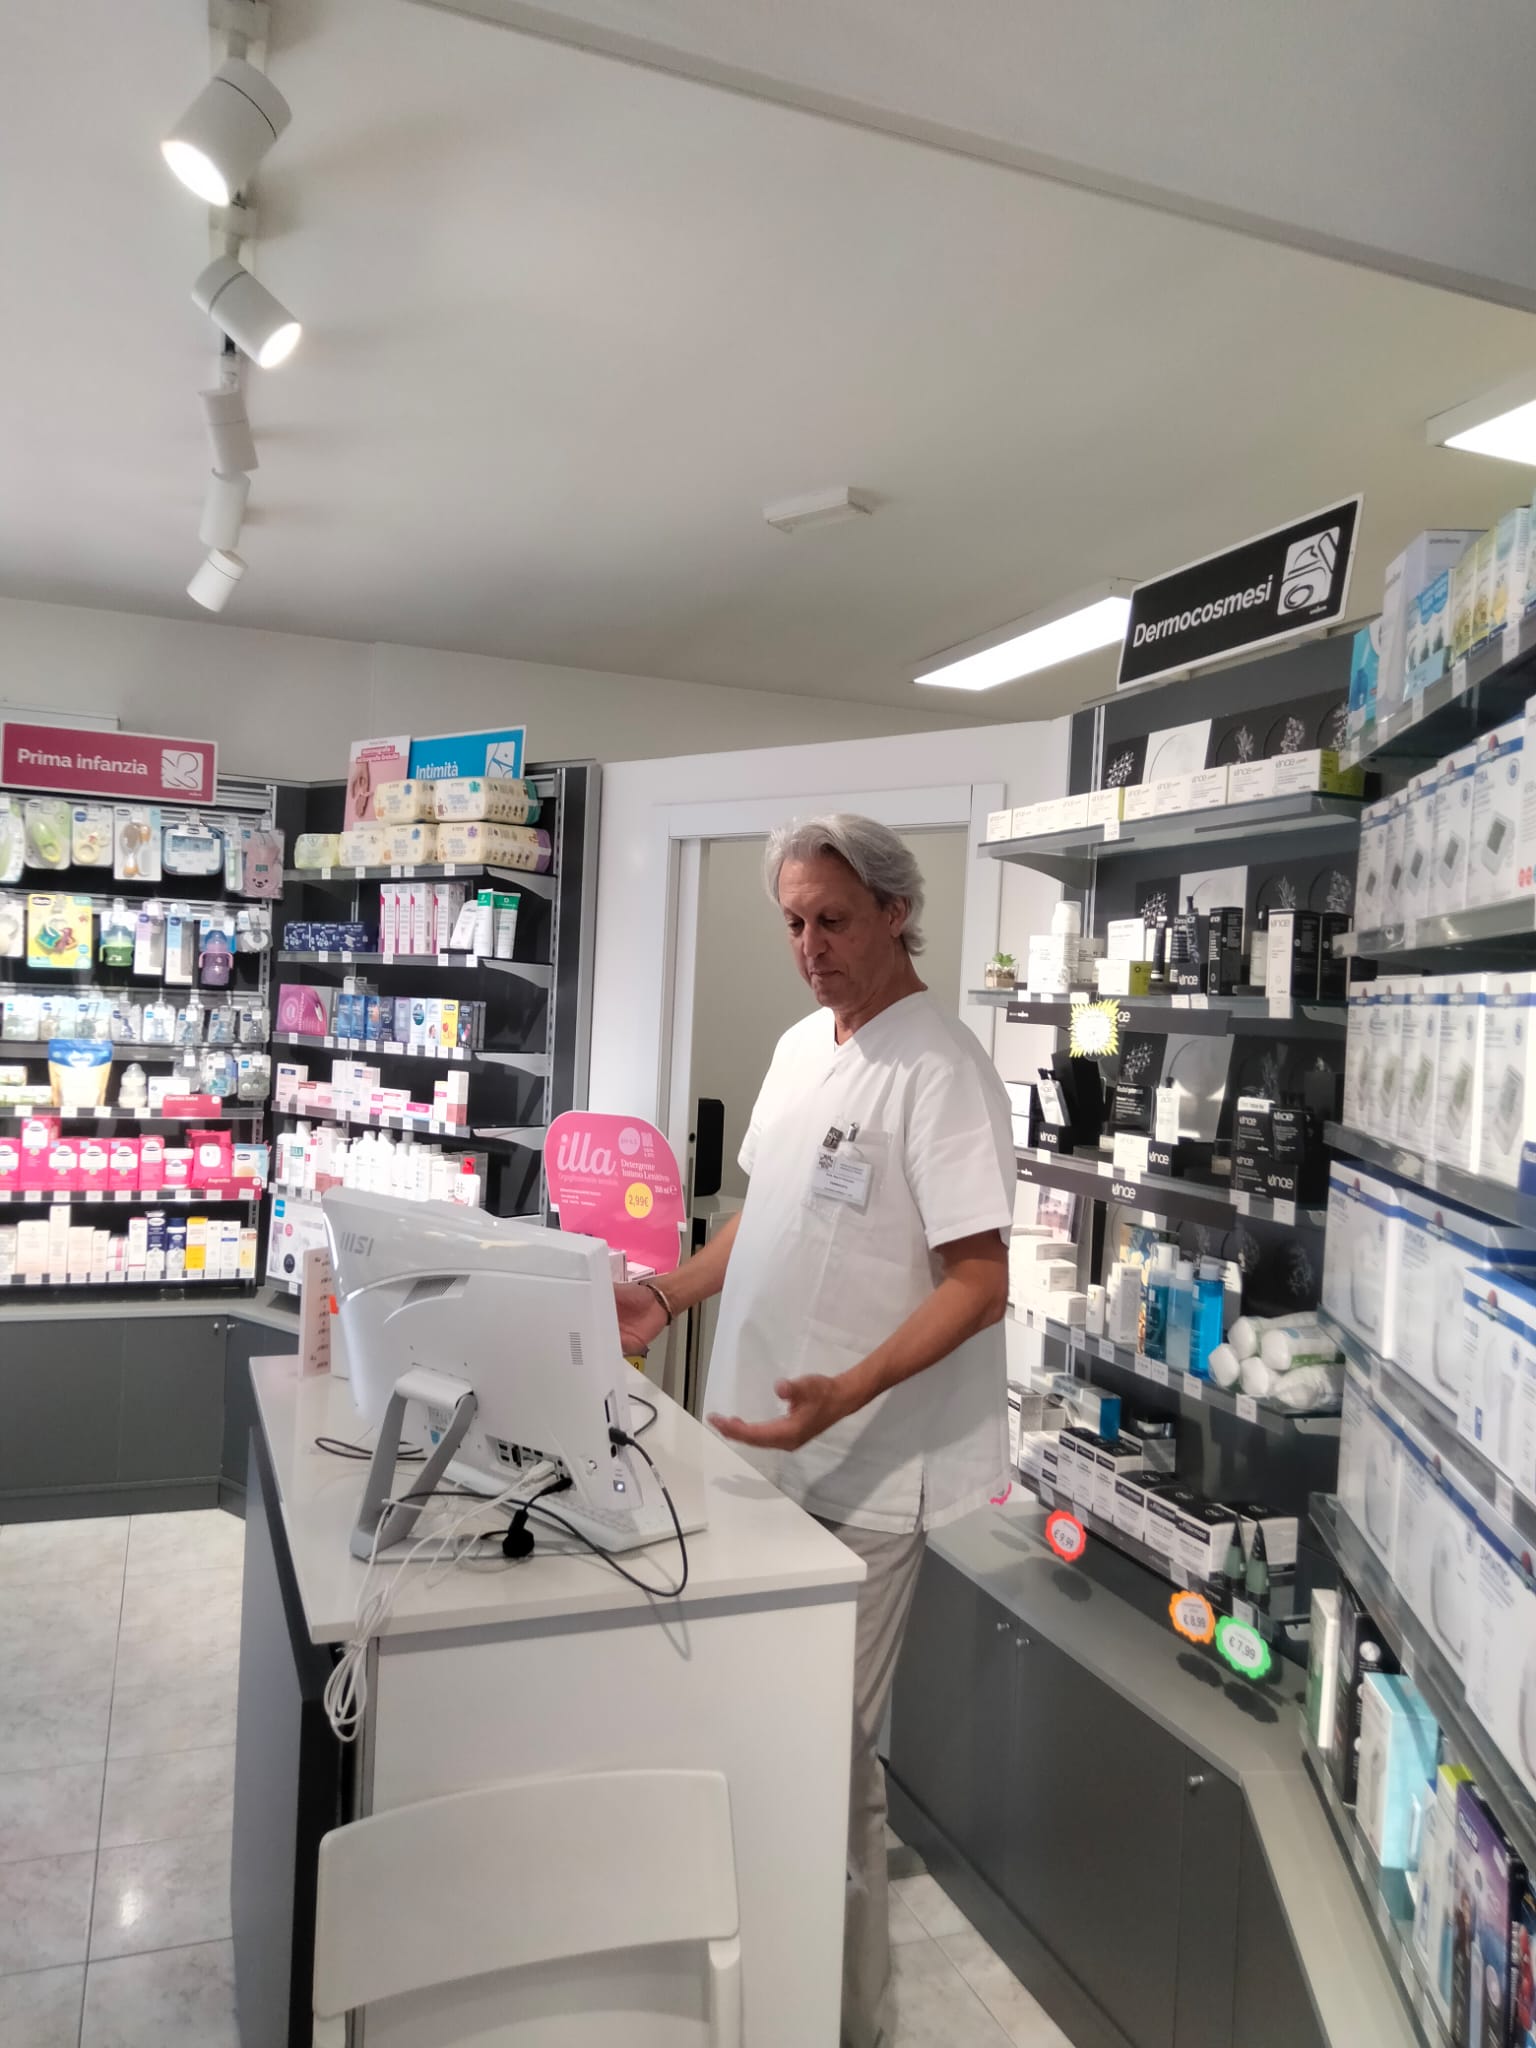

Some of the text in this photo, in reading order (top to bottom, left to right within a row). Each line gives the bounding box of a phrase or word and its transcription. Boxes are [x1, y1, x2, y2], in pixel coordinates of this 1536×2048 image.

[1133, 574, 1273, 648] Dermocosmesi
[17, 747, 149, 776] Prima infanzia
[416, 761, 459, 780] Intimità
[557, 1131, 617, 1176] illa
[628, 1194, 649, 1208] 2,99€
